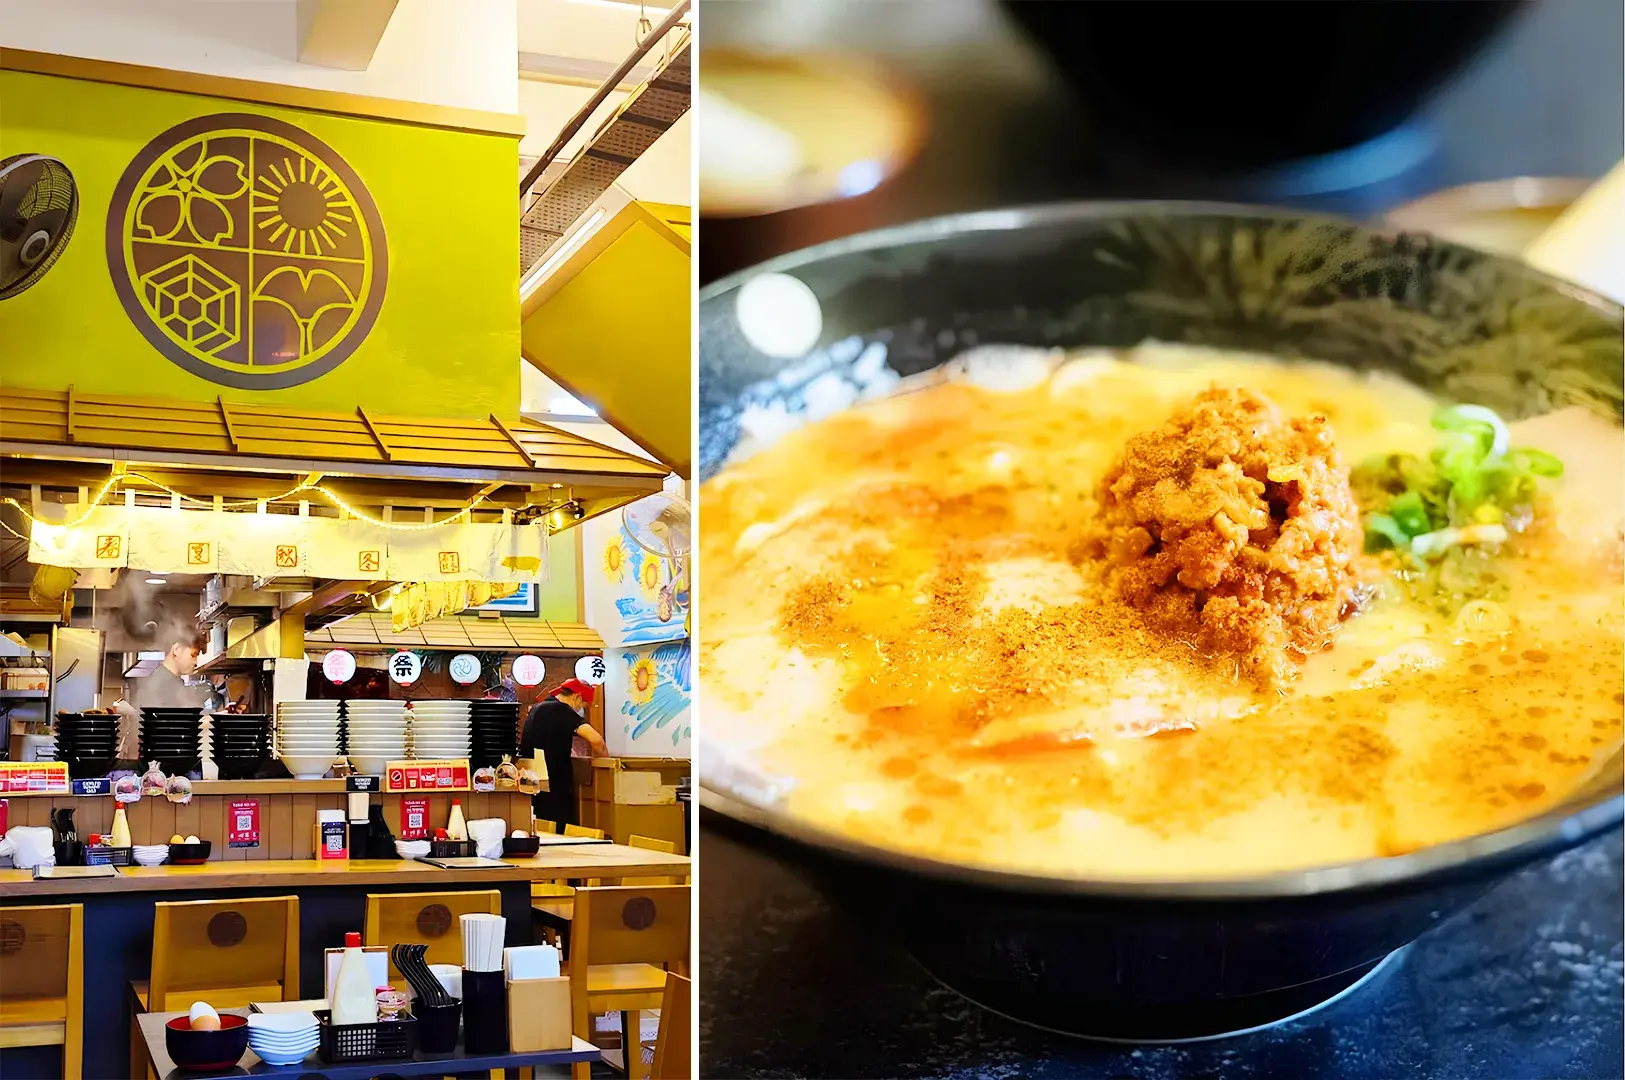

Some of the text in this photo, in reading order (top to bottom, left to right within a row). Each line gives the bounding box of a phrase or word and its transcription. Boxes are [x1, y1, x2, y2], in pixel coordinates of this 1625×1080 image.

[98, 537, 119, 557] 春
[277, 547, 296, 565] 秋
[361, 553, 380, 570] 冬
[394, 655, 413, 677] 祭
[590, 658, 606, 679] 祭
